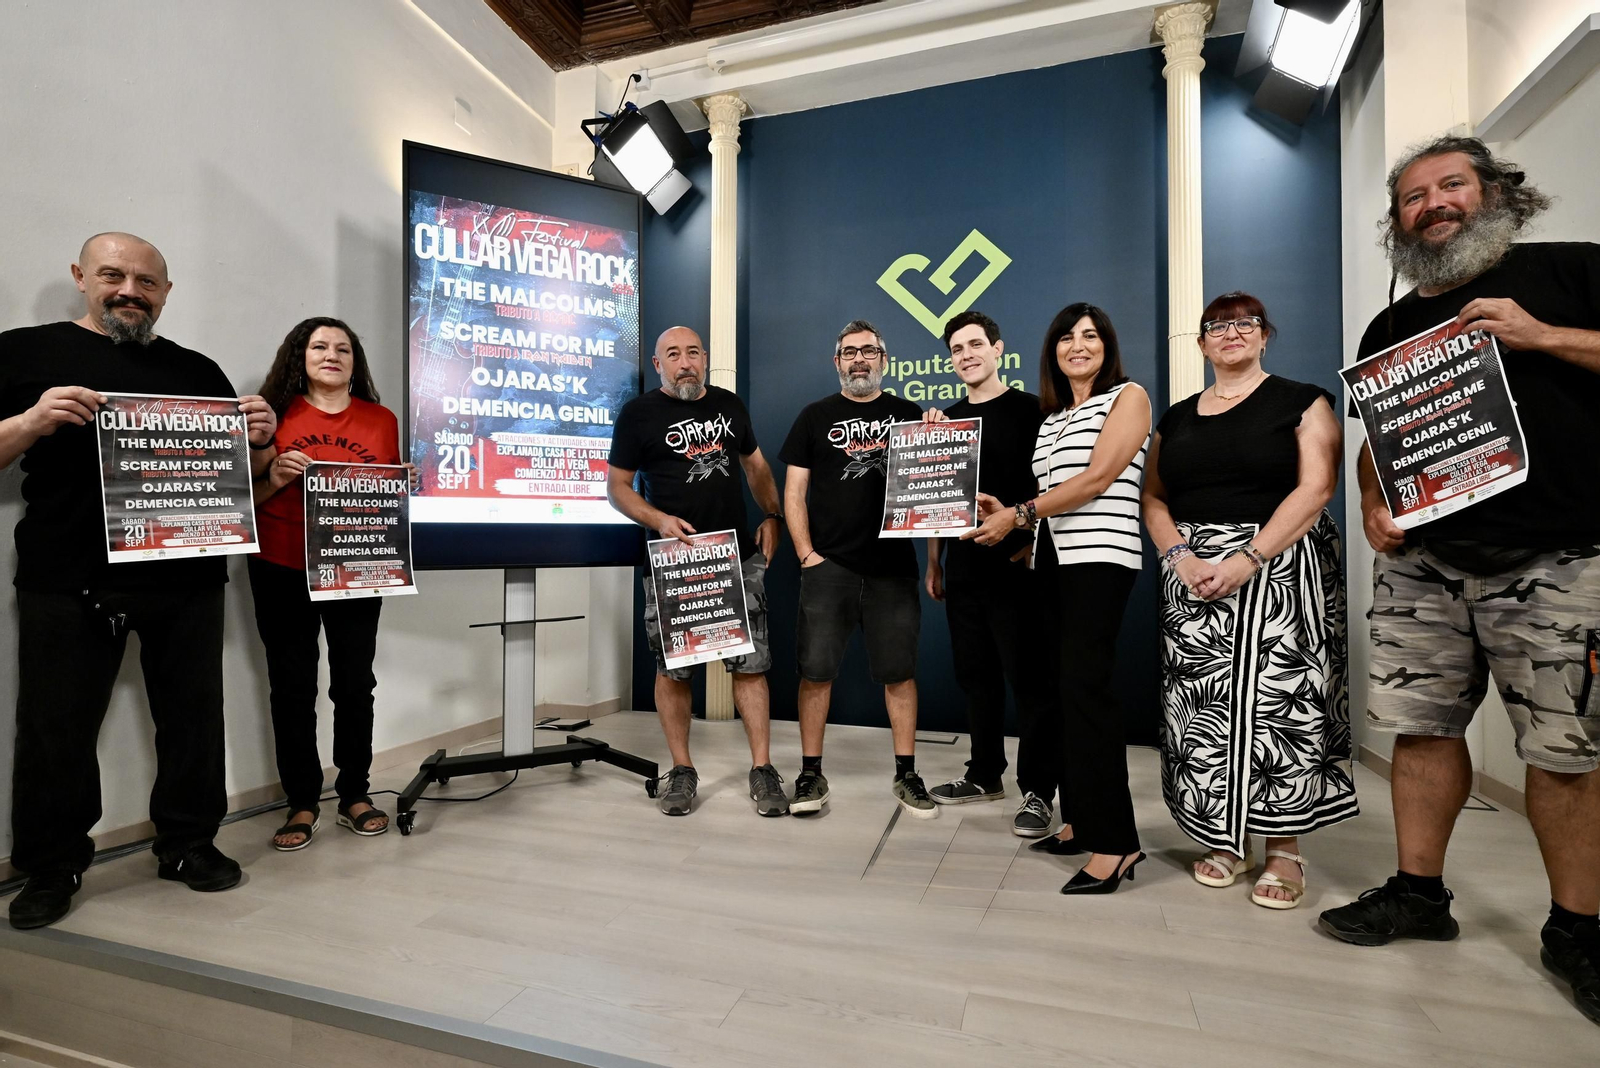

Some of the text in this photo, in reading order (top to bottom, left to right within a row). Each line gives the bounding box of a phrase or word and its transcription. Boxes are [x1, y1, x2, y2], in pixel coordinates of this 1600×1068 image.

[518, 218, 589, 250] Festival
[414, 219, 634, 288] CÚLLAR VEGA ROCK
[439, 276, 616, 319] THE MALCOLMS
[495, 303, 533, 321] TRIBUTO
[440, 322, 615, 358] SCREAM FOR ME
[473, 342, 512, 360] TRIBUTO
[521, 349, 550, 365] IRON
[551, 352, 593, 369] MAIDEN
[471, 367, 588, 395] OJARAS'K
[1352, 365, 1410, 401] CÚLLAR
[1405, 346, 1447, 378] VEGA
[1374, 394, 1400, 413] THE
[1400, 356, 1480, 402] MALCOLMS
[164, 401, 210, 415] Festival
[442, 396, 613, 425] DEMENCIA GENIL
[1380, 403, 1433, 434] SCREAM
[1434, 391, 1462, 410] FOR
[1463, 379, 1486, 398] ME
[100, 407, 243, 433] CÚLLAR VEGA ROCK
[1402, 410, 1473, 448] OJARAS'K
[118, 438, 232, 449] THE MALCOLMS
[434, 430, 474, 446] SÁBADO
[497, 434, 541, 445] ATRACCIONES
[548, 437, 588, 447] ACTIVIDADES
[588, 440, 611, 448] INFANTI
[926, 431, 951, 446] VEGA
[951, 430, 978, 442] ROCK
[1392, 421, 1498, 471] DEMENCIA GENIL
[437, 445, 471, 475] 20
[496, 445, 543, 457] EXPLANADA
[545, 447, 566, 458] CASA
[567, 448, 577, 459] DE
[578, 449, 588, 459] LA
[899, 451, 915, 460] THE
[916, 446, 969, 459] MALCOLMS
[120, 461, 233, 471] SCREAM FOR ME
[567, 459, 590, 470] VEGA
[897, 467, 934, 476] SCREAM
[935, 463, 953, 472] FOR
[953, 462, 967, 470] ME
[1428, 465, 1456, 480] EXPLANADA
[1457, 459, 1471, 469] CASA
[1485, 444, 1508, 457] CULTURA
[1473, 459, 1488, 470] VEGA
[437, 474, 471, 491] SEPT
[515, 468, 605, 482] COMIENZO A LAS 19:00
[1442, 473, 1468, 488] COMIENZO
[1473, 467, 1483, 477] LAS
[1452, 480, 1477, 493] ENTRADA
[1476, 473, 1491, 485] LIBRE
[142, 482, 217, 493] OJARAS'K
[307, 473, 408, 494] CÚLLAR VEGA ROCK
[528, 482, 591, 495] ENTRADA LIBRE
[908, 478, 954, 490] OJARAS'K
[897, 489, 965, 502] DEMENCIA GENIL
[1398, 482, 1418, 503] 20
[125, 497, 235, 510] DEMENCIA GENIL
[318, 498, 399, 508] THE MALCOLMS
[1402, 496, 1420, 511] SEPT
[319, 517, 398, 525] SCREAM FOR ME
[893, 512, 906, 523] 20
[124, 525, 145, 540] 20
[333, 534, 386, 543] OJARAS'K
[125, 539, 146, 547] SEPT
[321, 547, 398, 556] DEMENCIA GENIL
[688, 547, 715, 563] VEGA
[713, 543, 737, 559] ROCK
[319, 569, 335, 581] 20
[664, 571, 681, 580] THE
[681, 563, 731, 578] MALCOLMS
[666, 584, 702, 597] SCREAM
[702, 581, 719, 591] FOR
[720, 579, 733, 588] ME
[679, 597, 724, 612] OJARAS'K
[671, 607, 736, 625] DEMENCIA GENIL
[672, 636, 685, 648] 20
